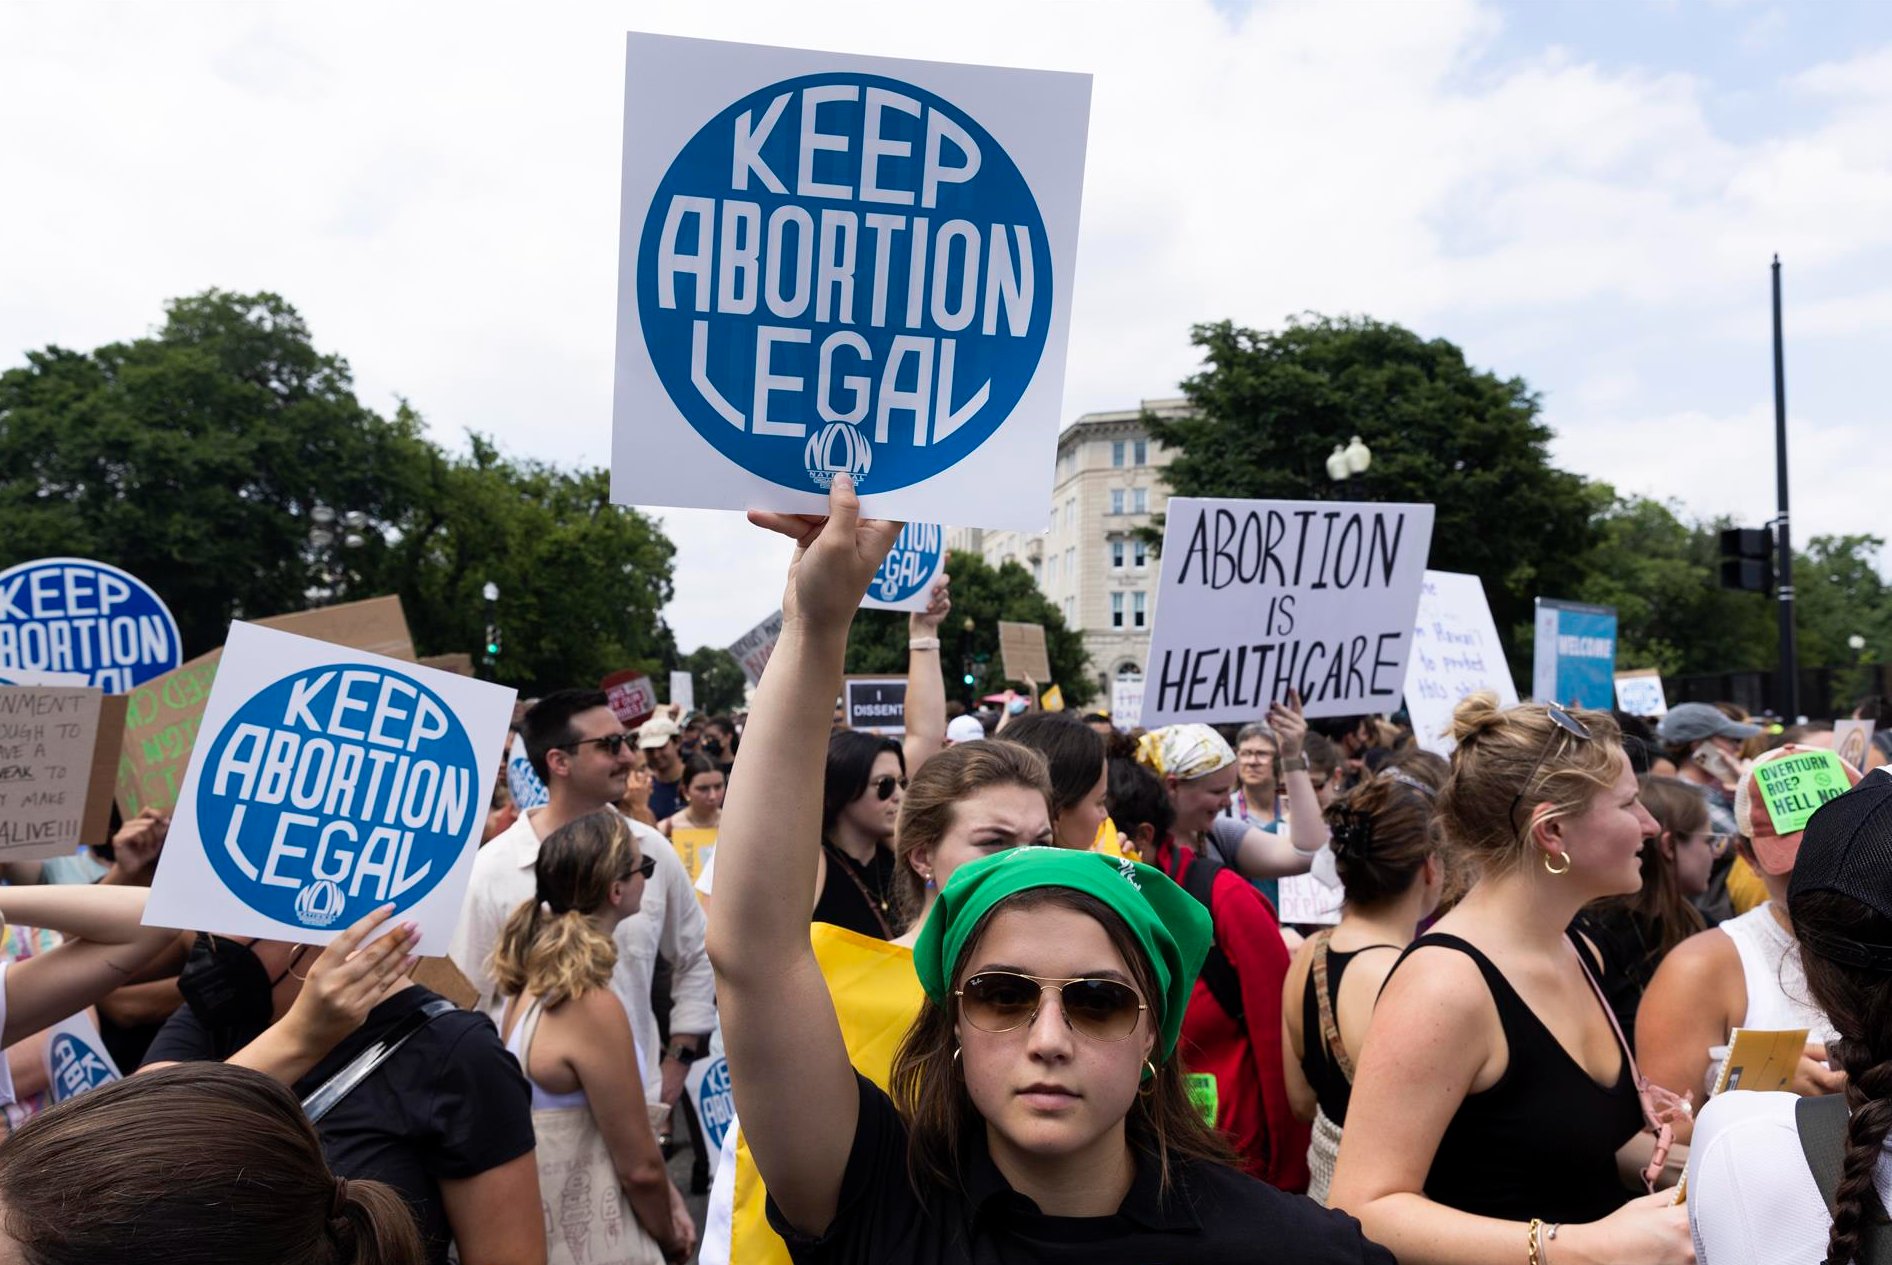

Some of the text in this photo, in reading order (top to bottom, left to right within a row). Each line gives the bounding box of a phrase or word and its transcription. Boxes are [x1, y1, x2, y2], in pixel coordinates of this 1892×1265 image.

[731, 84, 982, 209] KEEP
[657, 194, 1035, 338] ABORTION
[690, 319, 991, 447] LEGAL
[804, 423, 872, 474] NOW
[1177, 508, 1404, 590] ABORTION
[0, 567, 131, 621] KEEP
[1266, 595, 1295, 636] IS
[1157, 632, 1402, 712] HEALTHCARE
[55, 724, 82, 739] TO
[283, 670, 449, 753] KEEP
[853, 704, 904, 717] DISSENT
[34, 743, 46, 758] A
[45, 766, 66, 780] TO
[1761, 756, 1830, 781] OVERTURN
[20, 792, 66, 808] MAKE
[213, 722, 470, 836] ABORTION
[1766, 776, 1800, 797] ROE?
[1773, 793, 1815, 816] HELL
[224, 804, 432, 900] LEGAL
